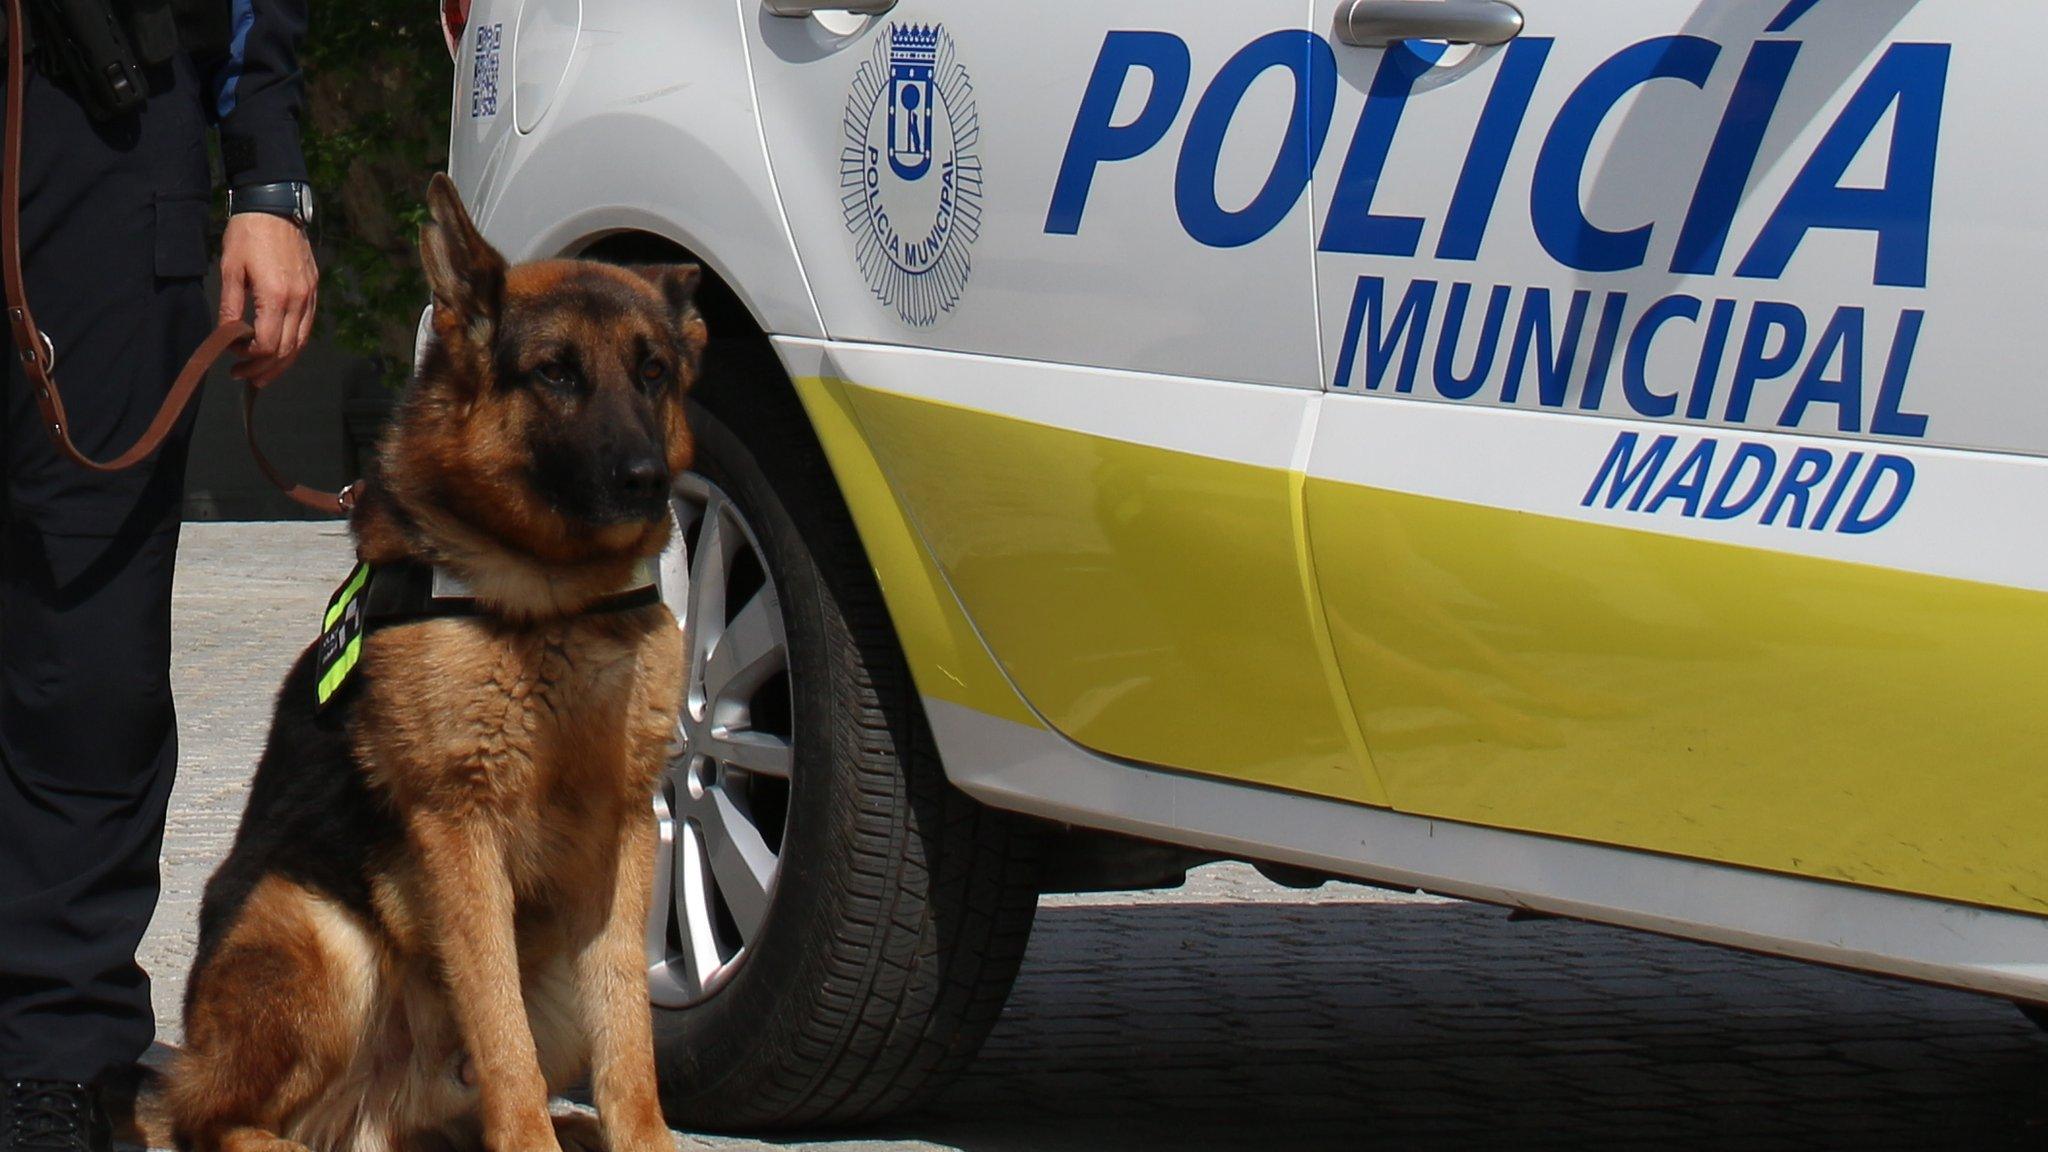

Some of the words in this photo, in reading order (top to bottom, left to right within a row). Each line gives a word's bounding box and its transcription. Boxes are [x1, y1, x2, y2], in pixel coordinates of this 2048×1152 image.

[867, 145, 899, 259] POLICIA
[905, 150, 954, 267] MUNICIPAL
[1044, 0, 1952, 289] POLICÍA
[1335, 277, 1930, 438] MUNICIPAL
[1583, 432, 1917, 537] MADRID
